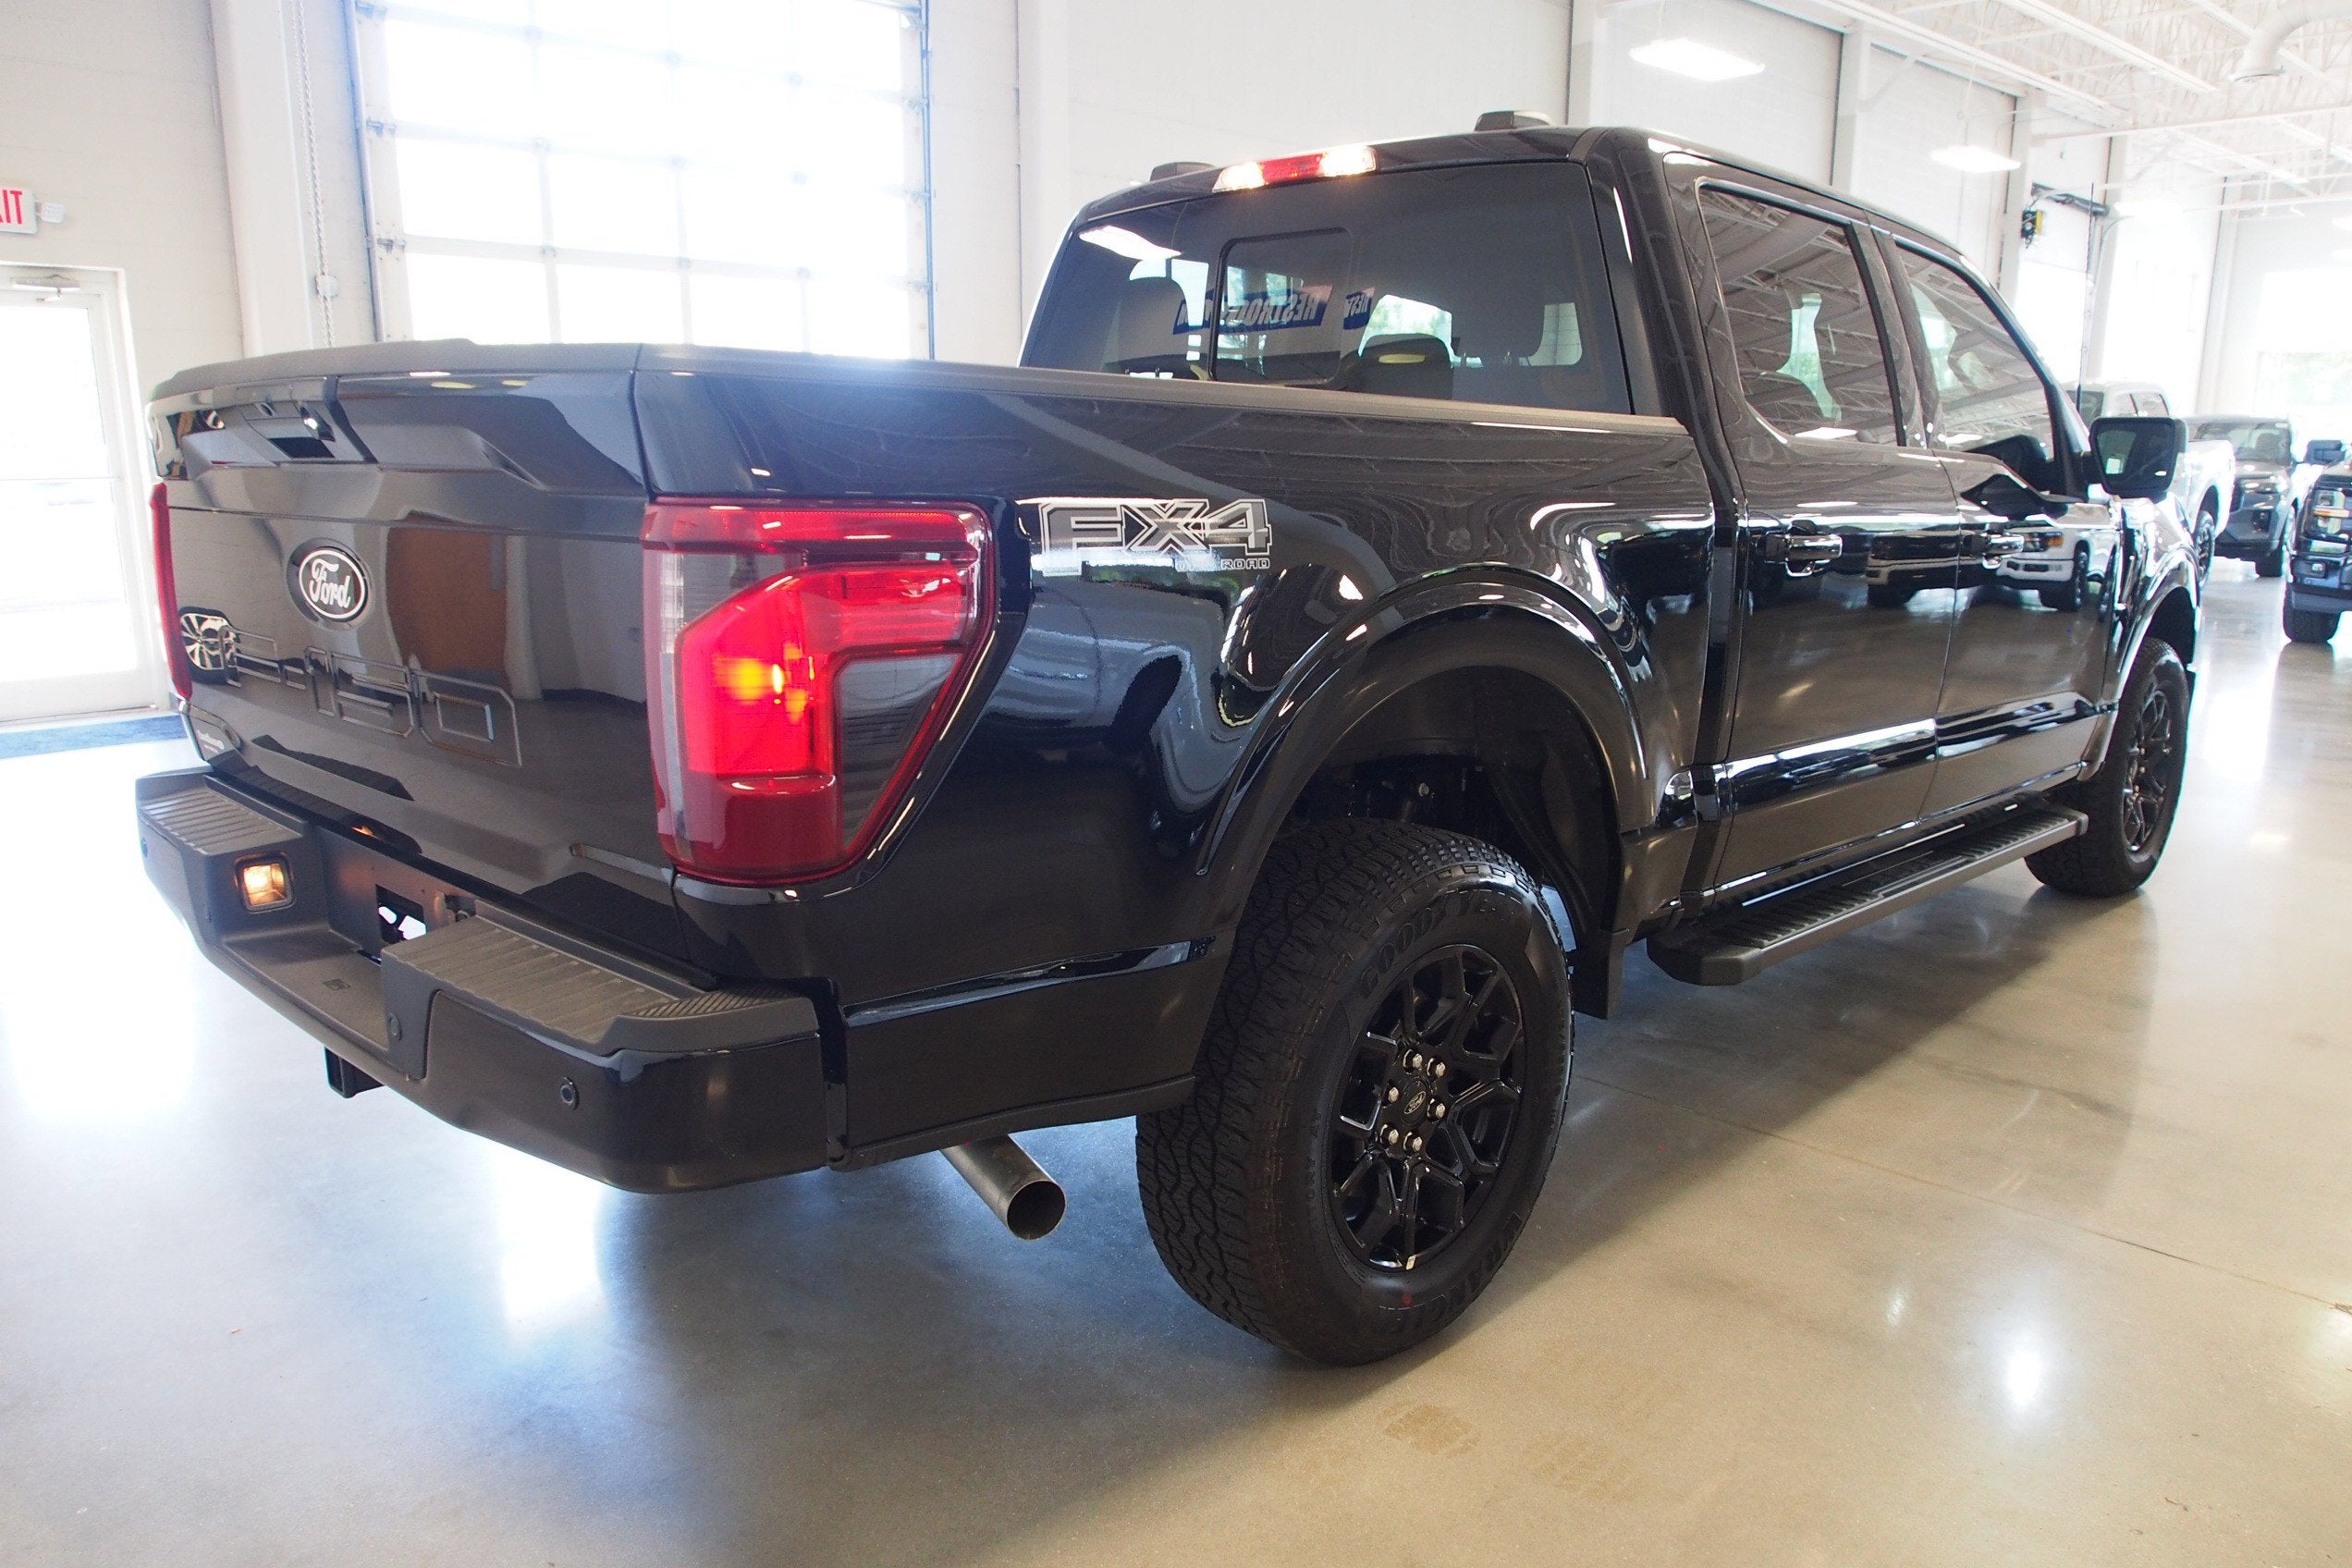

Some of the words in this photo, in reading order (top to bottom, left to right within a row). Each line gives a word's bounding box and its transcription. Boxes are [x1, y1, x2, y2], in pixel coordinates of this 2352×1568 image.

[0, 189, 23, 225] IT
[1037, 497, 1273, 576] FX4
[309, 558, 351, 609] Ford
[1220, 557, 1270, 570] ROAD
